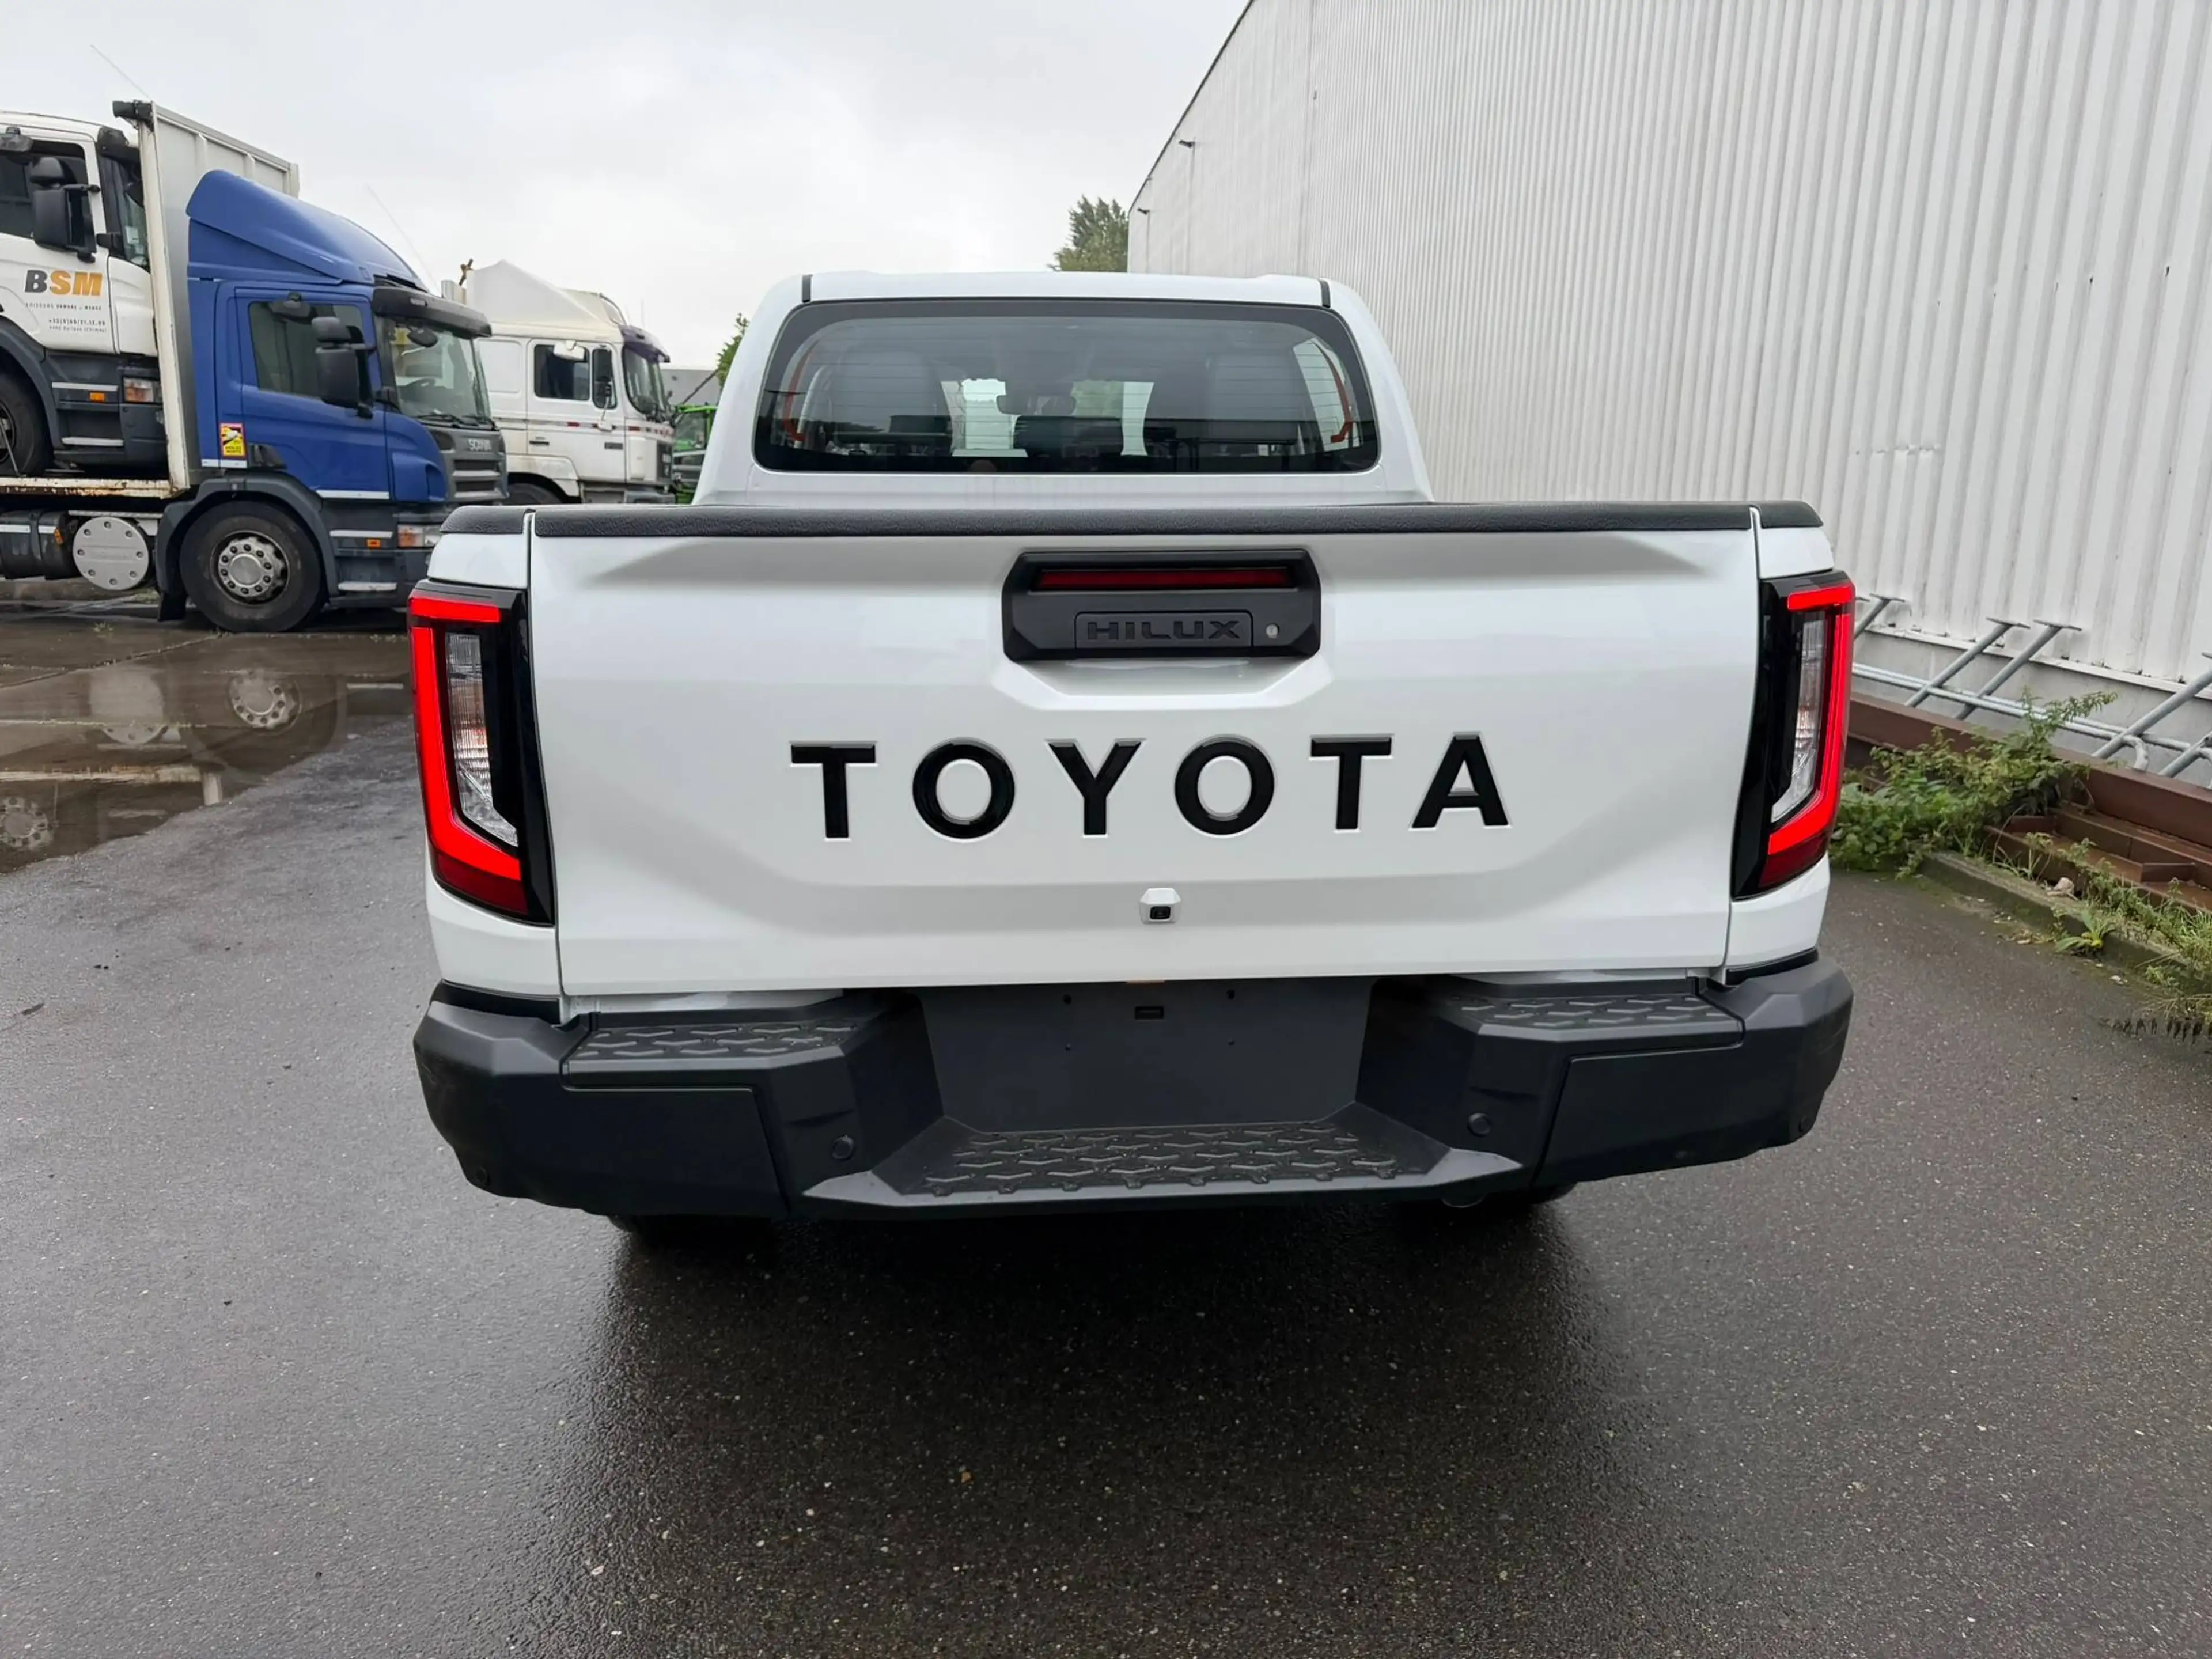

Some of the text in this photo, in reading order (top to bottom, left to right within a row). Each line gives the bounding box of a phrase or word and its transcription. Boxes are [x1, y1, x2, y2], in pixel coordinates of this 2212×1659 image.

[25, 269, 103, 296] BSM
[1087, 620, 1241, 641] HILUX
[790, 732, 1509, 840] TOYOTA
